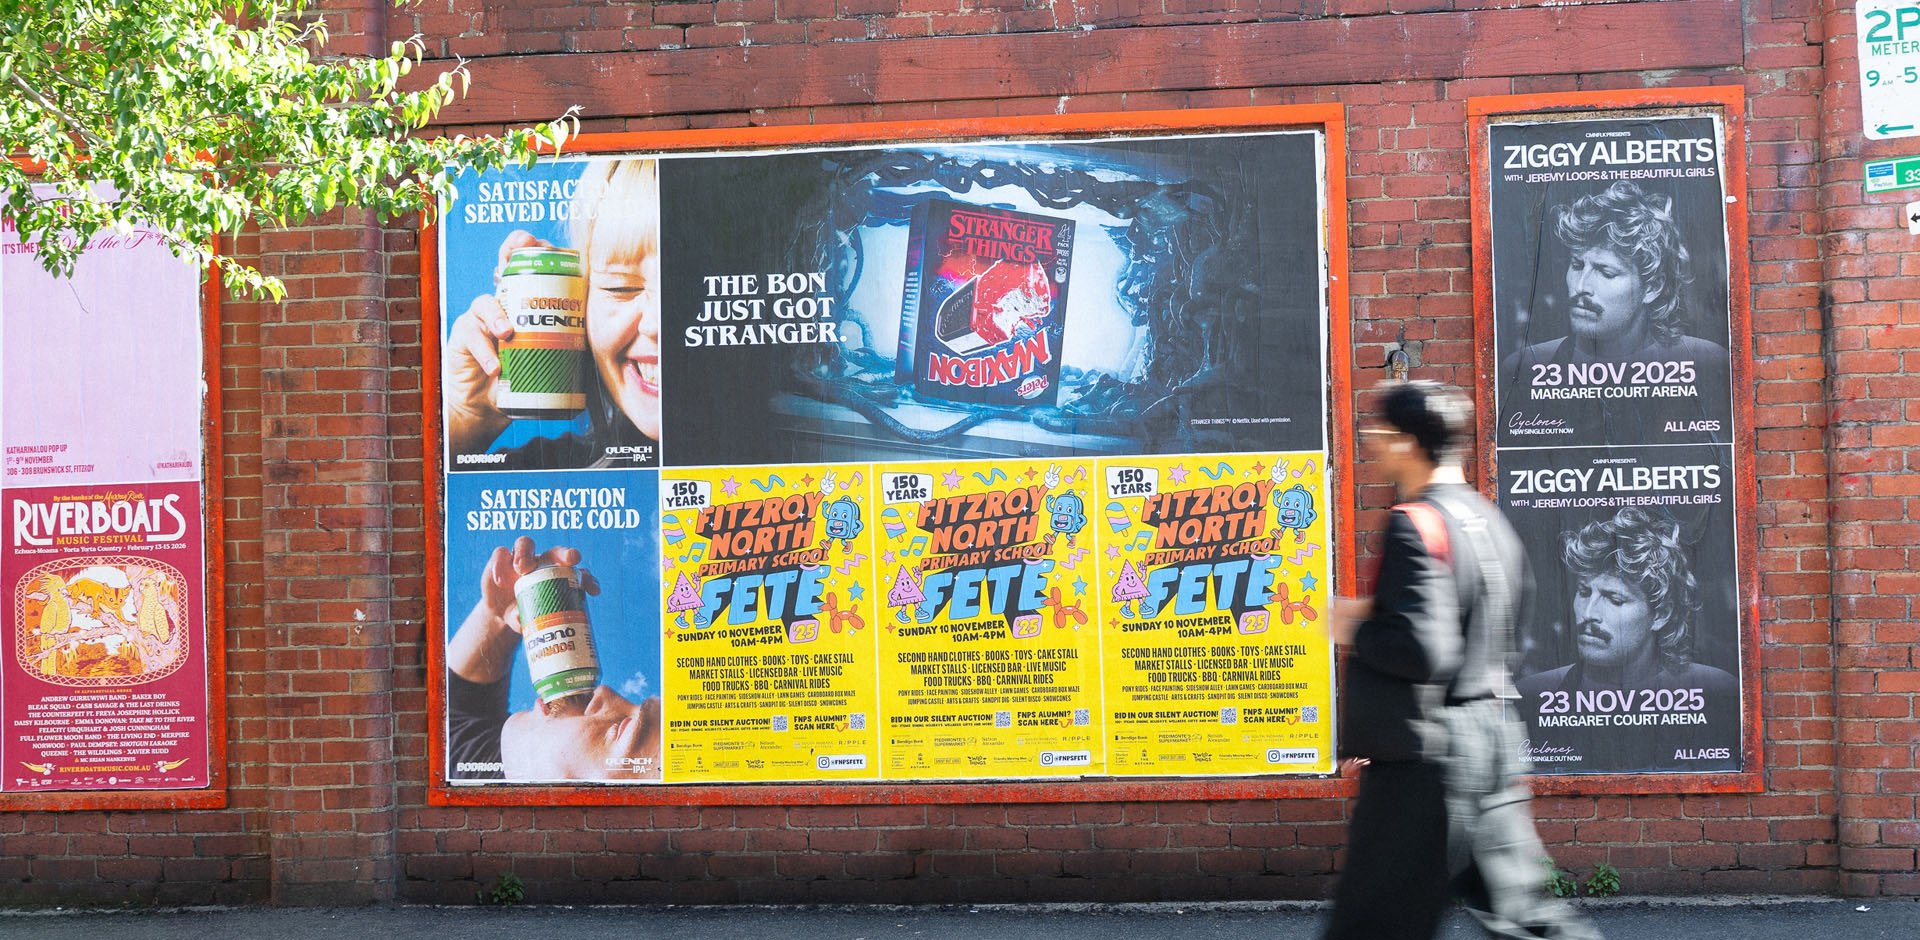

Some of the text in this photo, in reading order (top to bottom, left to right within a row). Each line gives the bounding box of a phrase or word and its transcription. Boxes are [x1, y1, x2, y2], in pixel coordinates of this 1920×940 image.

[1864, 7, 1920, 43] 2P
[1872, 41, 1920, 56] METER
[1504, 138, 1714, 169] ZIGGY ALBERTS
[1504, 168, 1715, 183] WITH JEREMY LOOPS & THE BEAUTIFUL GIRLS
[464, 201, 580, 224] SERVED ICE
[948, 214, 1053, 251] STRANGER
[16, 243, 36, 254] TIME
[966, 237, 1036, 263] THINGS
[704, 272, 827, 297] THE BON
[696, 297, 835, 322] JUST GOT
[516, 314, 585, 328] QUENCH
[685, 322, 847, 348] STRANGER.
[928, 330, 1052, 388] MAXIBON
[1532, 361, 1696, 386] 23 NOV 2025
[1017, 376, 1050, 397] Peters
[1530, 385, 1698, 400] MARGARET COURT ARENA
[1508, 412, 1566, 429] Cyclones
[1664, 420, 1720, 432] ALL AGES
[60, 444, 68, 452] UP
[606, 446, 652, 456] QUENCH
[24, 456, 53, 464] NOVEMBER
[456, 453, 507, 464] BODRIGGY
[632, 454, 646, 462] IPA
[33, 466, 64, 474] BRUNSWICK
[1117, 469, 1144, 482] 150
[893, 475, 919, 489] 150
[1510, 465, 1720, 494] ZIGGY ALBERTS
[672, 482, 698, 496] 150
[886, 488, 926, 501] YEARS
[1111, 482, 1152, 495] YEARS
[480, 488, 626, 510] SATISFACTION
[666, 495, 705, 508] YEARS
[916, 484, 1049, 528] FITZROY
[1141, 479, 1276, 522] FITZROY
[14, 494, 186, 546] RIVERBOATS
[466, 508, 640, 531] SERVED ICE COLD
[696, 491, 825, 534] FITZROY
[930, 514, 1039, 554] NORTH
[1155, 510, 1267, 549] NORTH
[56, 534, 144, 545] MUSIC FESTIVAL
[708, 521, 816, 560] NORTH
[97, 545, 122, 553] Country
[920, 544, 1053, 571] PRIMARY SCHOOL
[1144, 539, 1280, 566] PRIMARY SCHOOL
[700, 549, 830, 576] PRIMARY SCHOOL
[917, 560, 1055, 624] FETE
[1141, 555, 1282, 619] FETE
[696, 565, 832, 630] FETE
[898, 620, 1005, 637] SUNDAY 10 NOVEMBER
[1122, 616, 1231, 632] SUNDAY 10 NOVEMBER
[1178, 614, 1267, 638] 10AM-4PM '25
[677, 626, 782, 642] SUNDAY 10 NOVEMBER
[731, 624, 816, 648] 10AM-4PM '25
[952, 630, 1006, 642] 10AM-4PM
[676, 653, 854, 668] SECOND HAND CLOTHES BOOKS TOYS CAKE STALL
[690, 665, 843, 680] MARKET STALLS LICENSED BAR LIVE MUSIC
[702, 678, 830, 692] FOOD TRUCKS BBQ CARNIVAL RIDES
[1539, 688, 1704, 714] 23 NOV 2025
[736, 718, 770, 726] AUCTION!
[816, 722, 835, 730] HERE
[1538, 713, 1707, 728] MARGARET COURT ARENA
[1518, 738, 1574, 756] Cyclones
[1674, 748, 1730, 760] ALL AGES
[632, 765, 646, 774] IPA
